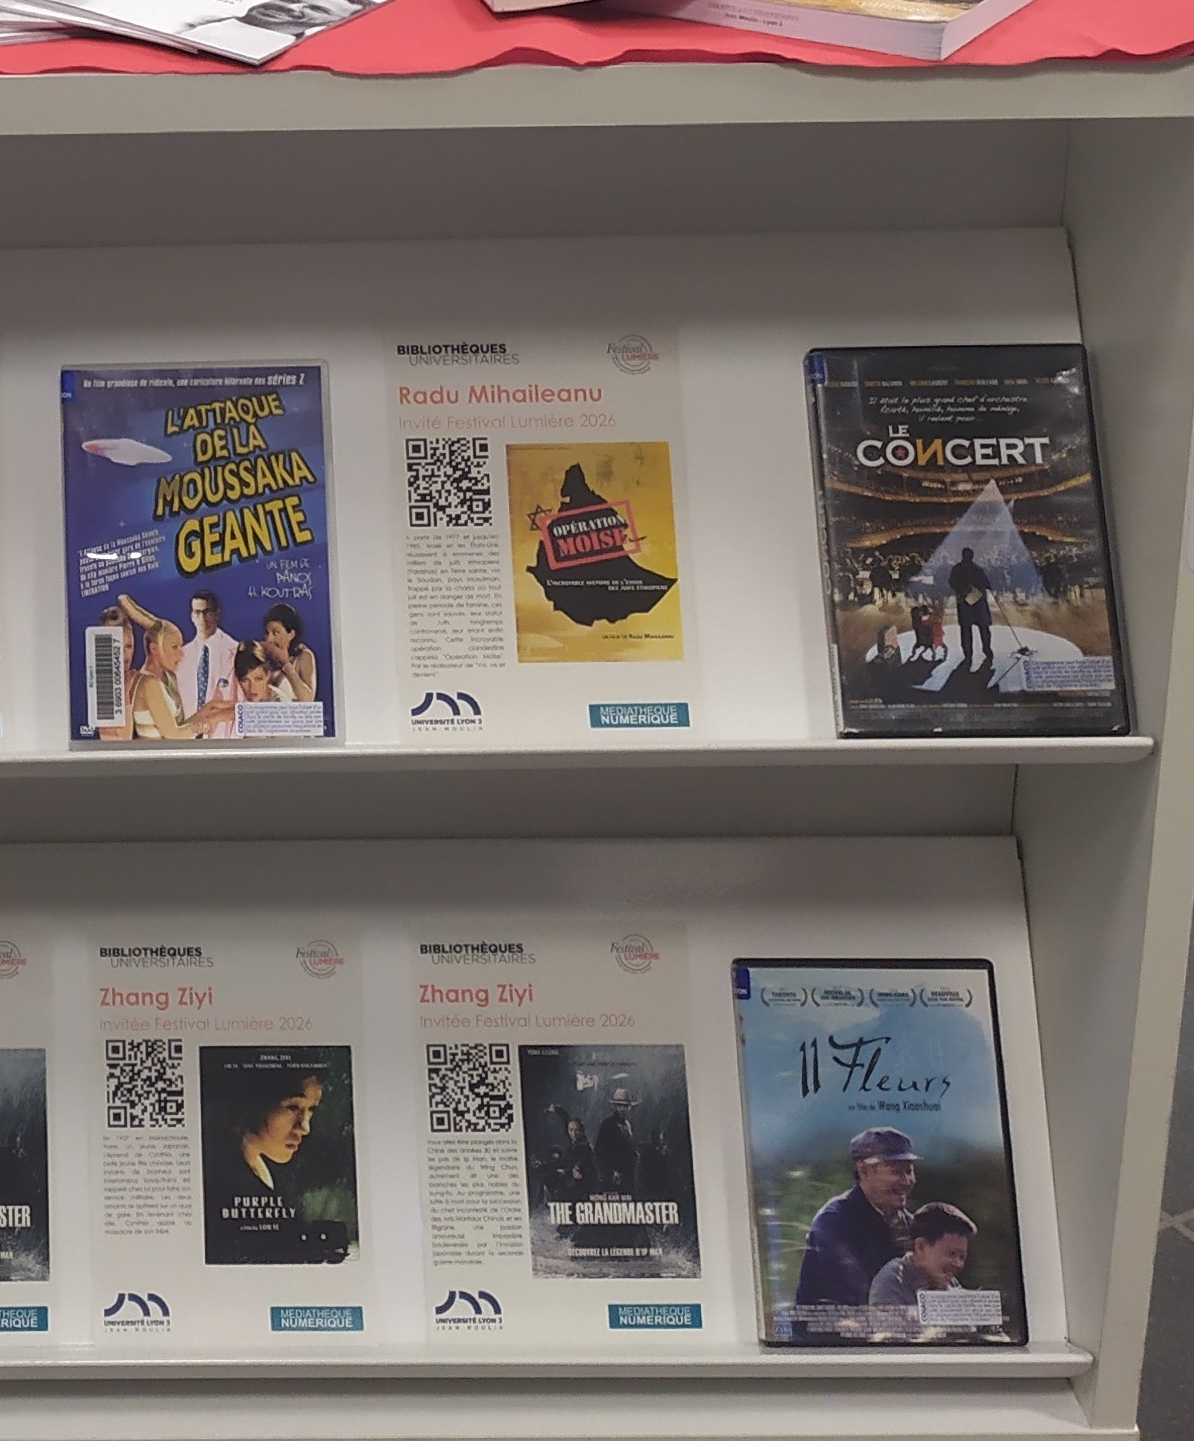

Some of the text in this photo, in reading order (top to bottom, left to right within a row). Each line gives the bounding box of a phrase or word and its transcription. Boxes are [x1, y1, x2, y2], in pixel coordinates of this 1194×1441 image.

[397, 341, 507, 356] BIBLIOTHÈQUES
[398, 384, 603, 405] Radu Mihaileanu
[166, 393, 285, 435] L'ATTAQUE
[888, 424, 910, 437] LE
[195, 424, 268, 461] DE LA
[156, 452, 315, 516] MOUSSAKA
[177, 497, 313, 573] GEANTE
[553, 514, 626, 538] OPÉRATION
[276, 569, 312, 586] PANOS
[261, 583, 313, 600] KOUTRAS
[99, 987, 214, 1010] Zhang Ziyi
[419, 983, 534, 1007] Zhang Ziyi
[828, 1034, 951, 1098] Fleurs
[877, 1099, 942, 1112] Wang Xiaoshuai
[234, 1196, 284, 1208] PURPLE
[546, 1201, 679, 1225] THE GRANDMASTER
